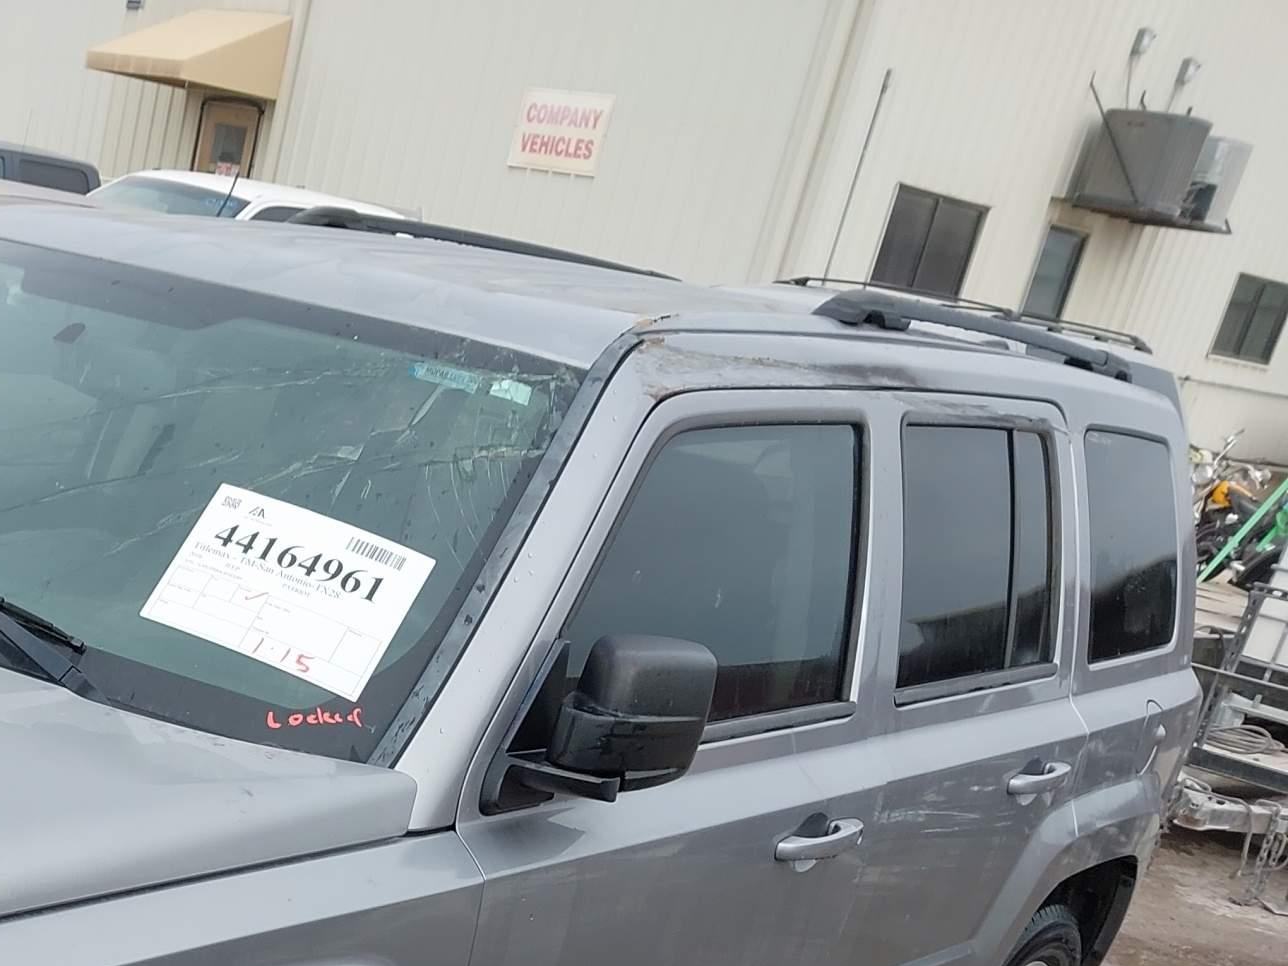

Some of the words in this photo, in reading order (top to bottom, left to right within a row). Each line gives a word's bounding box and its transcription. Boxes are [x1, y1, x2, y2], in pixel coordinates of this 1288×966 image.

[526, 102, 604, 130] COMPANY
[521, 132, 594, 160] VEHICLES
[214, 523, 384, 604] 44164961
